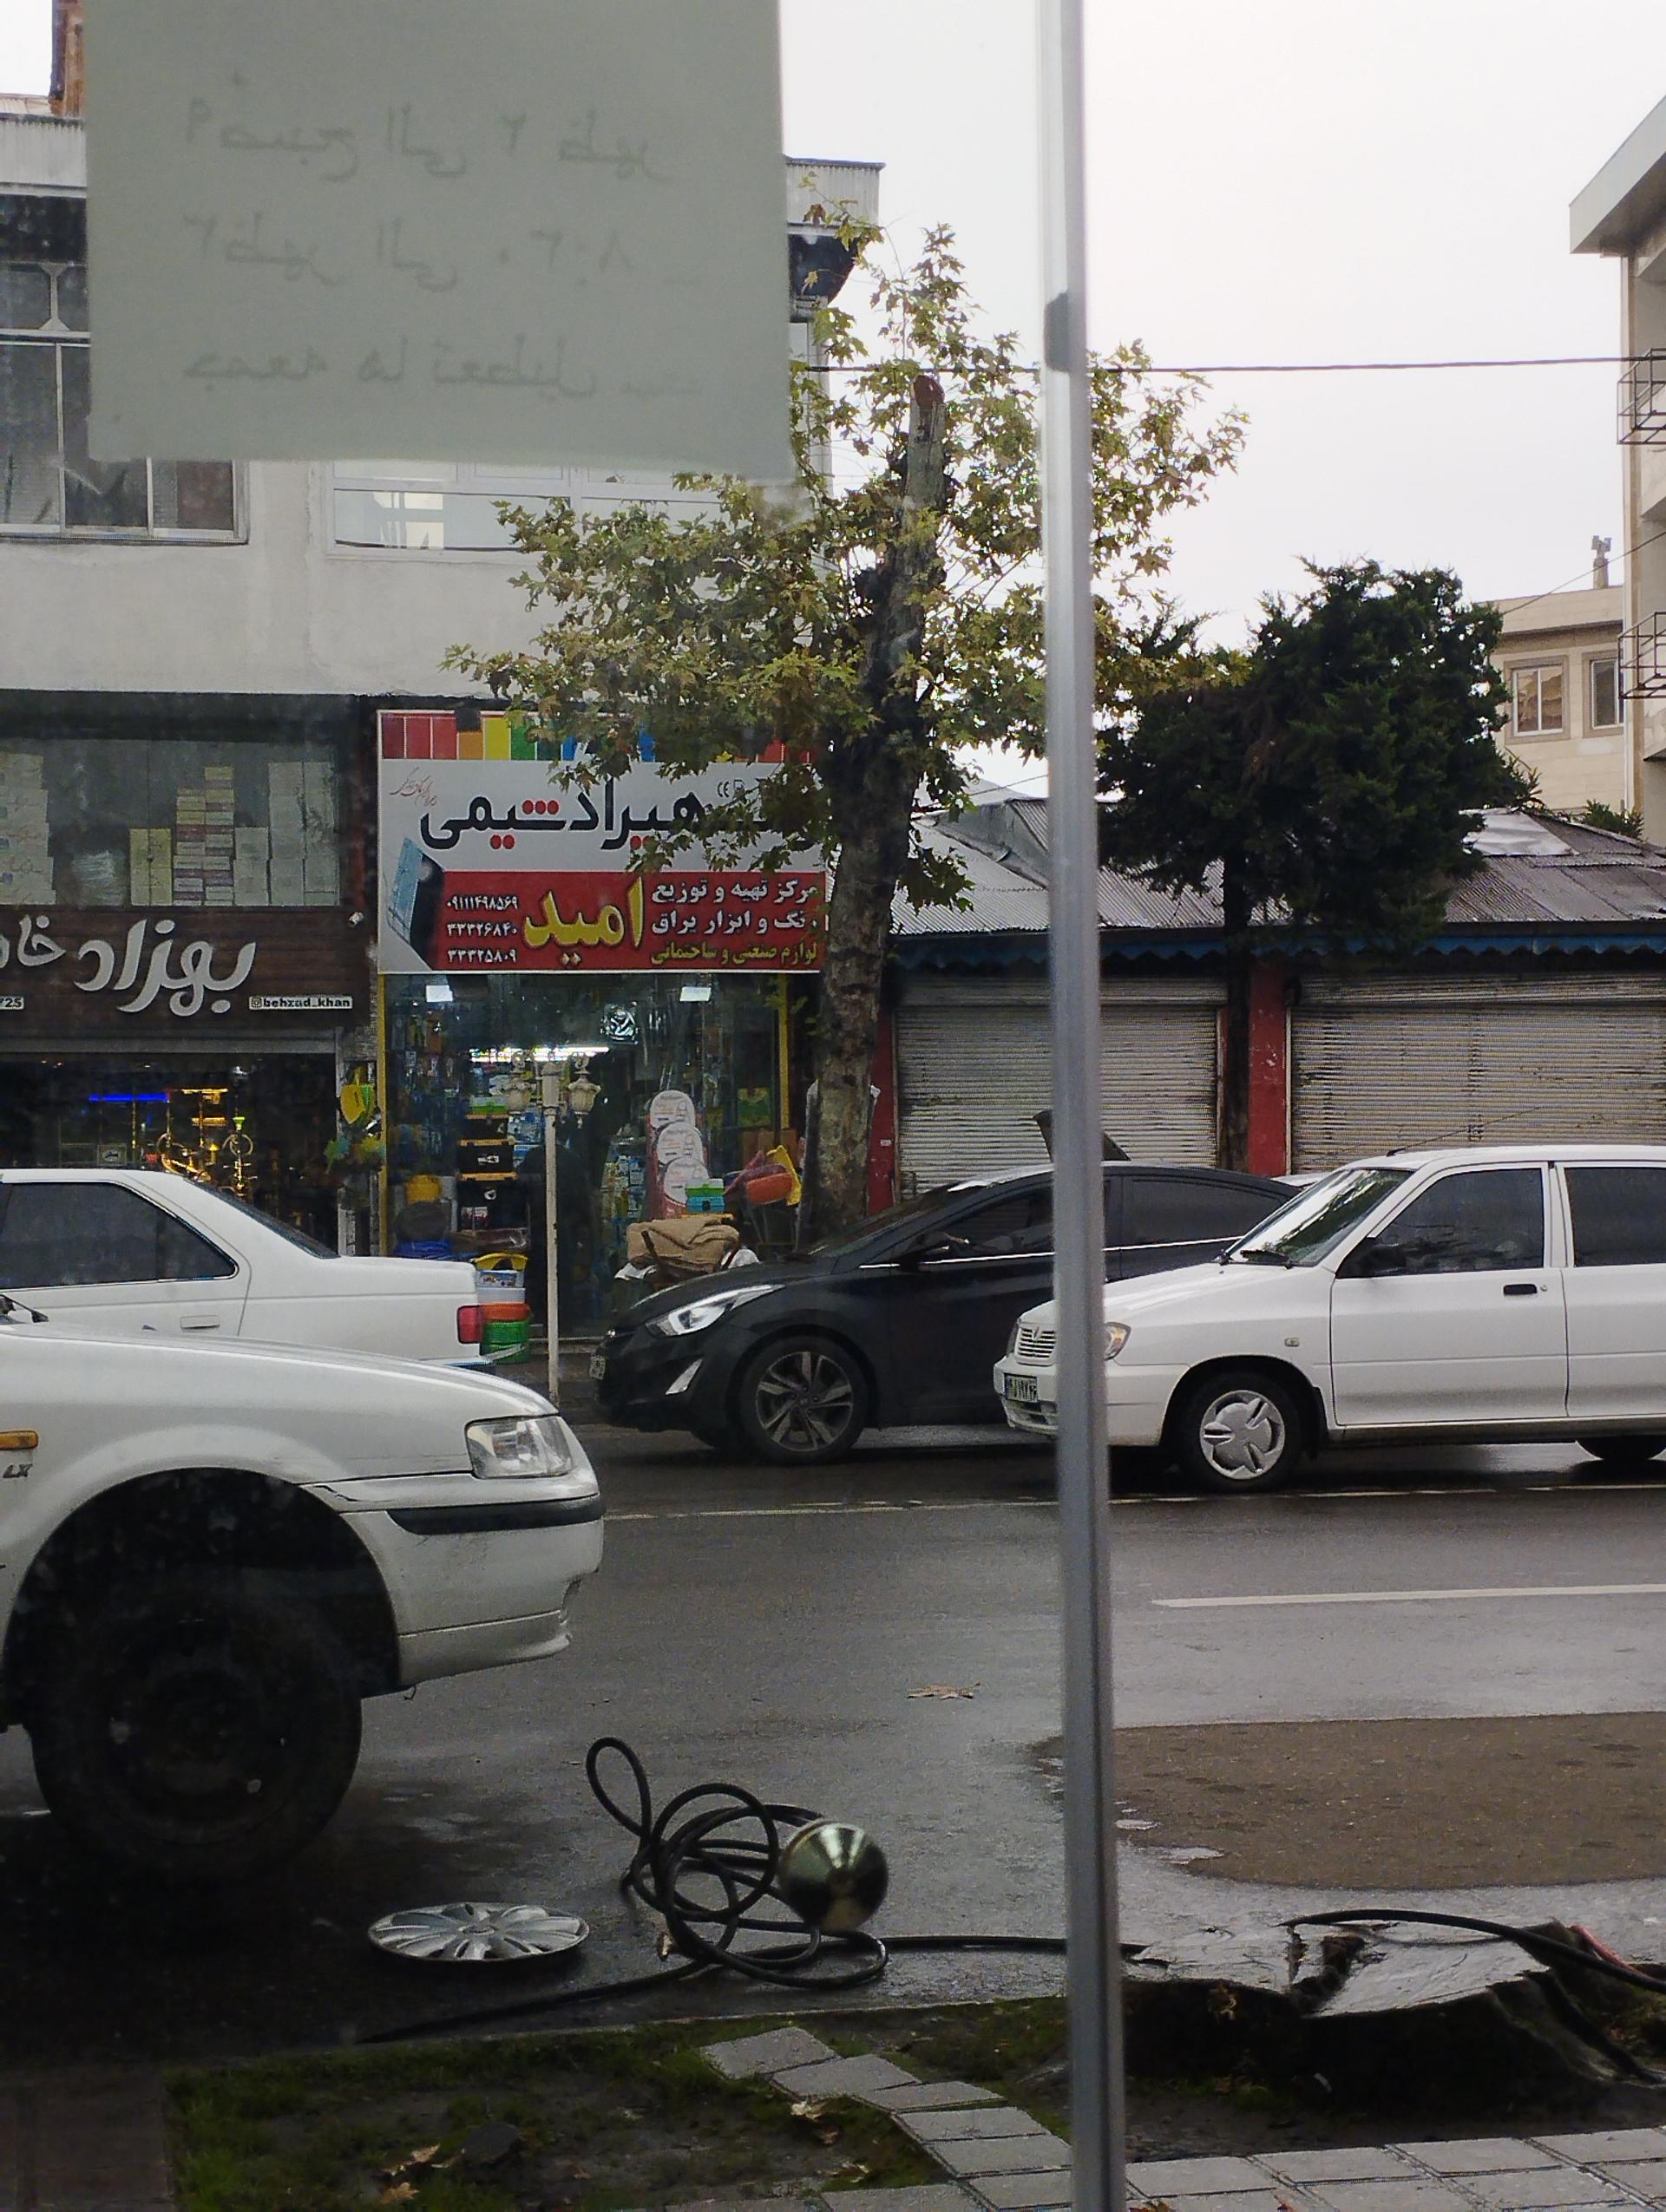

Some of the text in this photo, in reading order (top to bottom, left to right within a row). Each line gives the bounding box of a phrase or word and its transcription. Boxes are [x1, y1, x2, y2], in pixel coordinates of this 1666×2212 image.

[652, 880, 709, 904] توزیع
[712, 886, 725, 904] و
[731, 880, 769, 901] تهیه
[523, 875, 645, 966] امید
[652, 909, 817, 934] نگ و ابزار یراق
[651, 940, 818, 965] لوازم صنعتی و ساختمانی
[72, 919, 258, 1018] بهزاد
